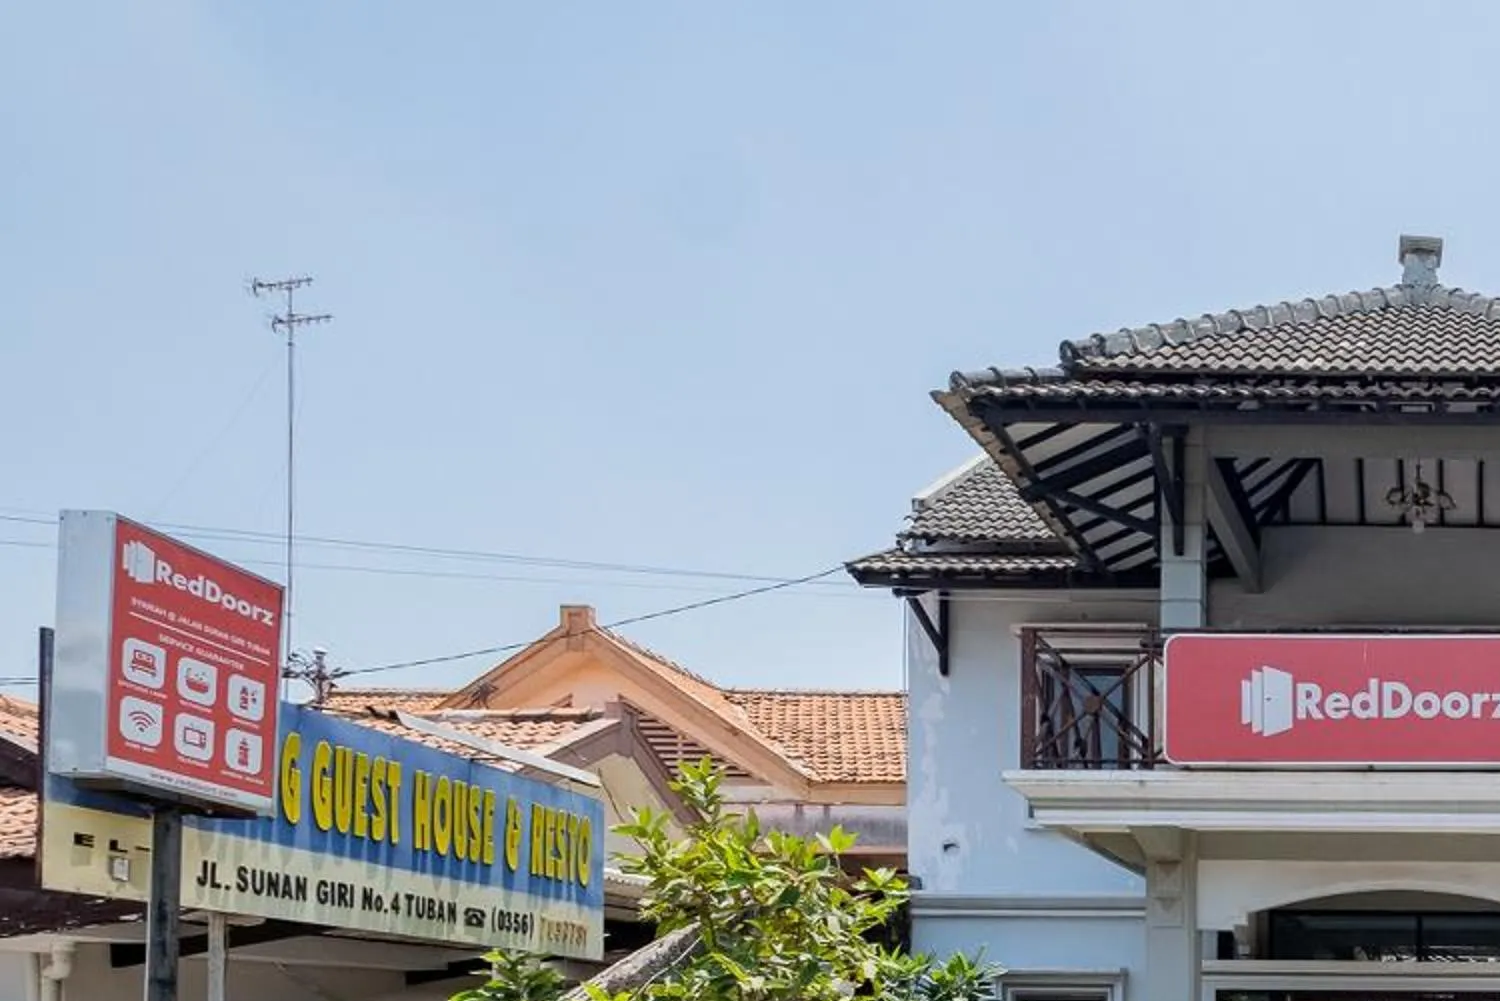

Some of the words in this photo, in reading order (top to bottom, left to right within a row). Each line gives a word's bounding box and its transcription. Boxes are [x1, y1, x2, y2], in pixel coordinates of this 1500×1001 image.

[155, 559, 275, 627] RedDoorz
[311, 739, 402, 847] GUEST
[413, 769, 496, 866] HOUSE
[505, 794, 522, 873] &
[529, 801, 593, 889] RESTO
[196, 859, 231, 891] JL.
[236, 865, 308, 902] SUNAN
[316, 879, 354, 909] GIRI
[404, 892, 457, 925] TUBAN
[491, 906, 534, 941] (0356)
